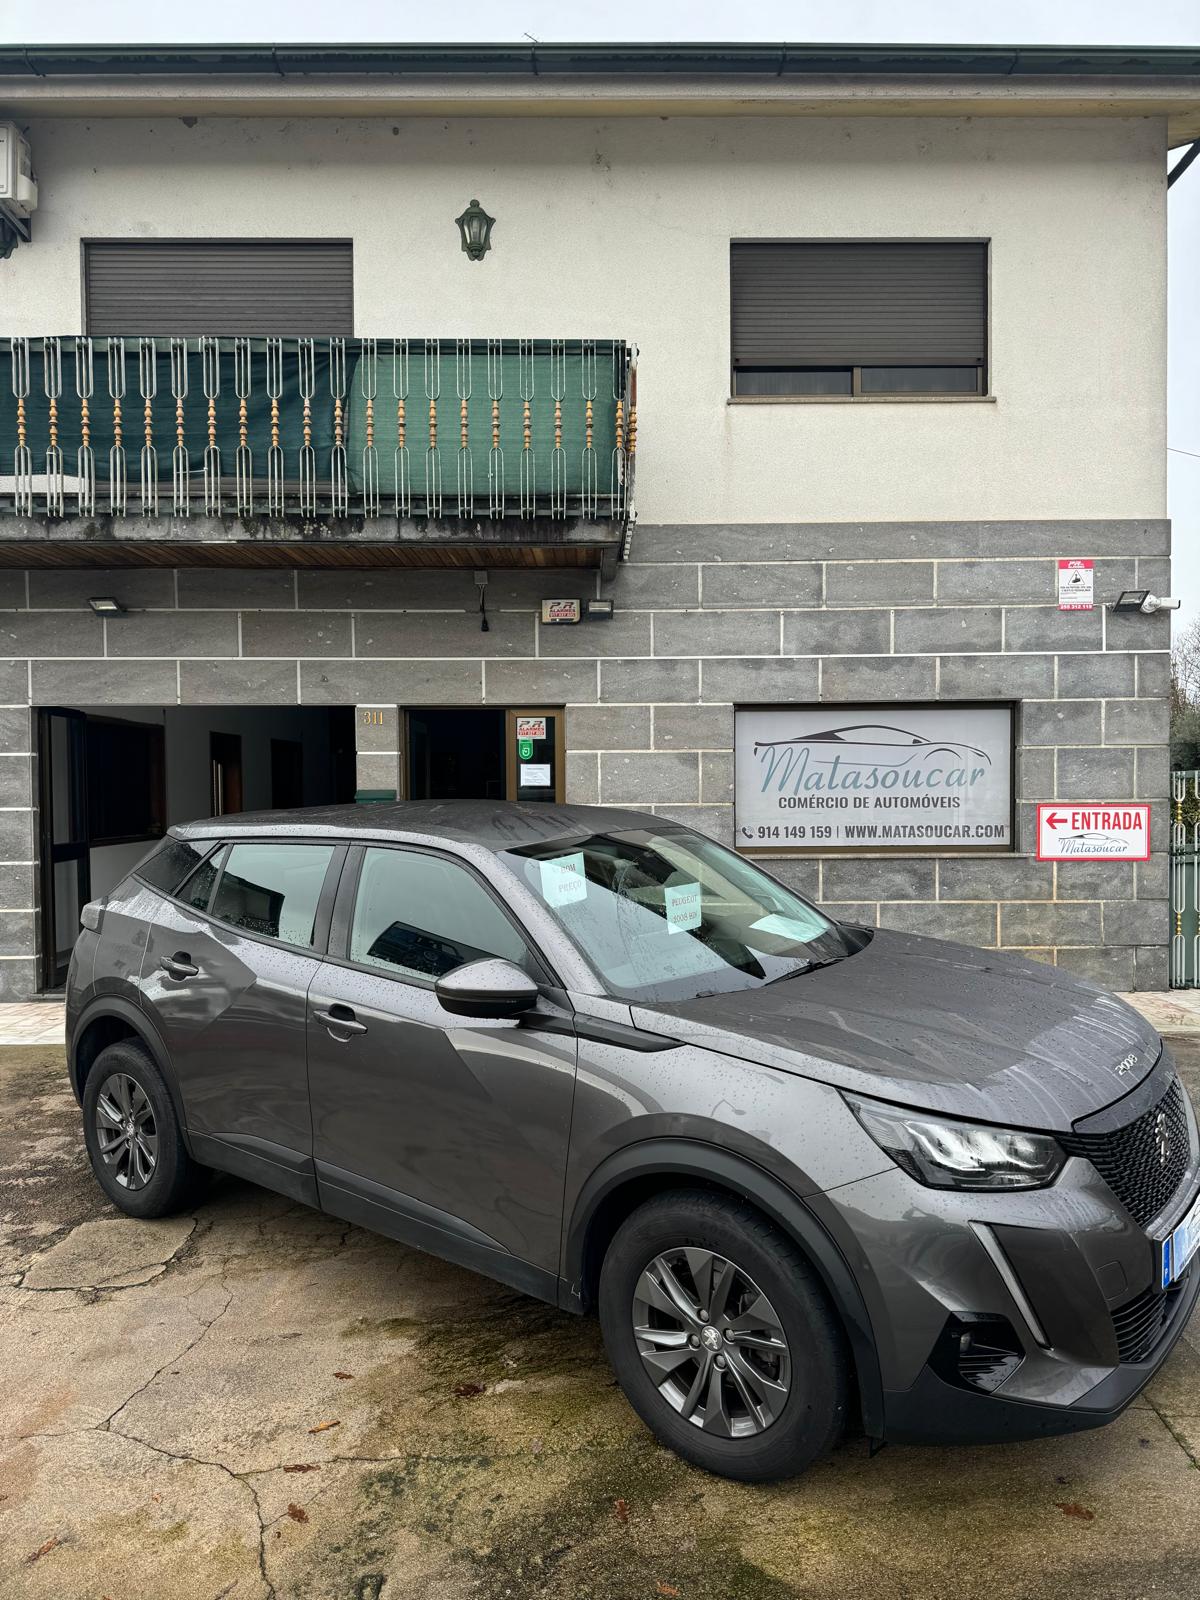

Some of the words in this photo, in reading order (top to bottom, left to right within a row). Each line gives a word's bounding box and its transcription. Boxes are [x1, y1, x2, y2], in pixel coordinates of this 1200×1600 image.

[363, 711, 384, 725] 311
[760, 746, 985, 796] Matasoucar
[778, 794, 849, 809] COMÉRCIO
[853, 796, 870, 809] DE
[874, 794, 961, 809] AUTOMÓVEIS
[1071, 811, 1143, 831] ENTRADA
[758, 826, 780, 839] 914
[783, 826, 806, 839] 149
[810, 825, 832, 839] 159
[845, 825, 1005, 839] WWW.MATASOUCAR.COM
[1059, 839, 1128, 854] Matasoucar
[1114, 1053, 1138, 1076] 2008
